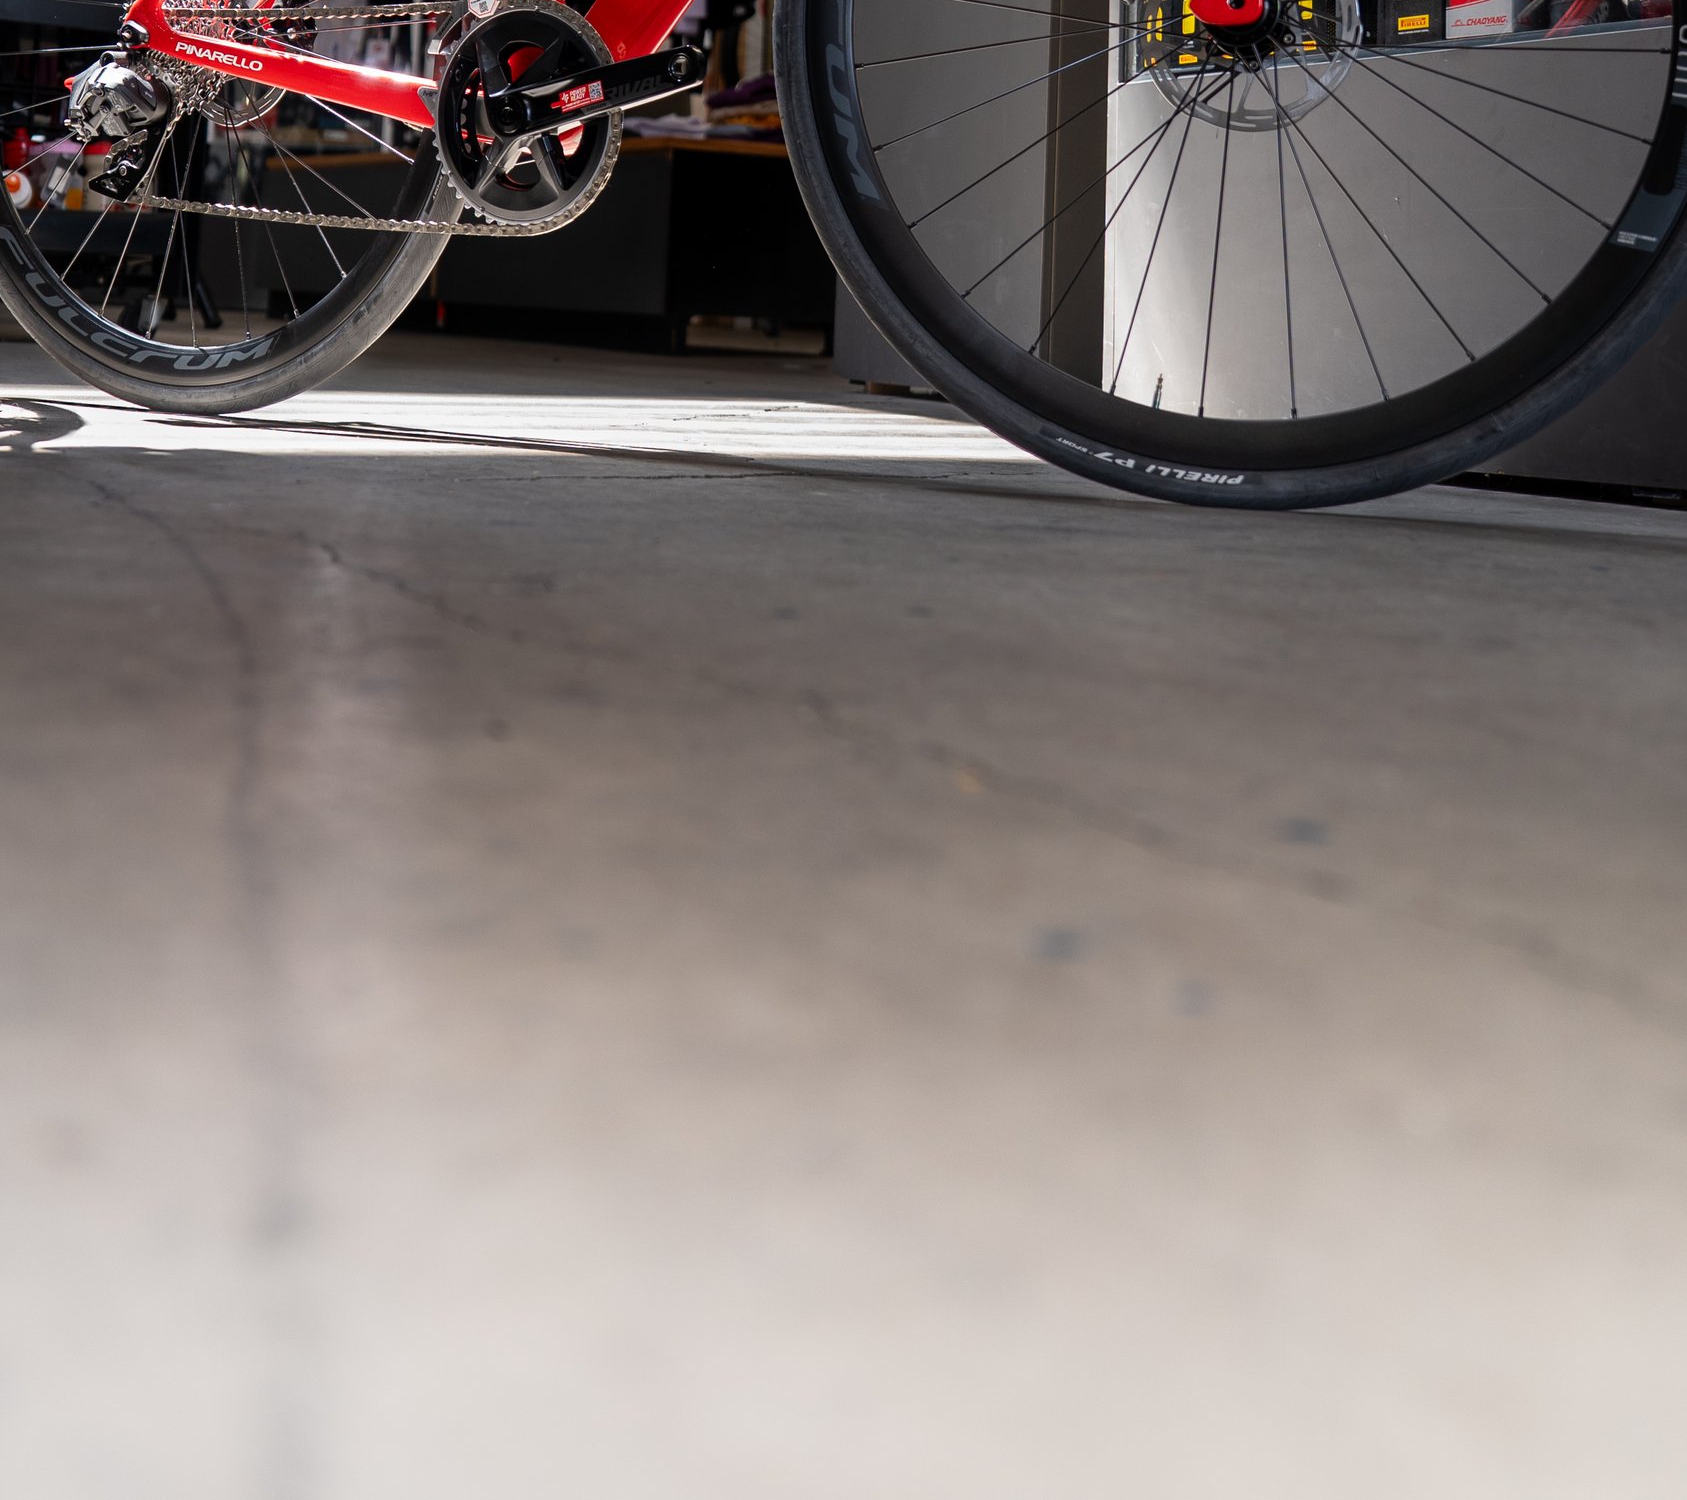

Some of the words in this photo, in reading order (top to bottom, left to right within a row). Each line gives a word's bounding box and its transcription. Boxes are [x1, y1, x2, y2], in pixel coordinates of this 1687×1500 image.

[175, 41, 263, 71] PINARELLO
[1, 227, 276, 371] FULCRUM
[1094, 451, 1136, 468] P7
[1146, 464, 1244, 485] PIRELLI
